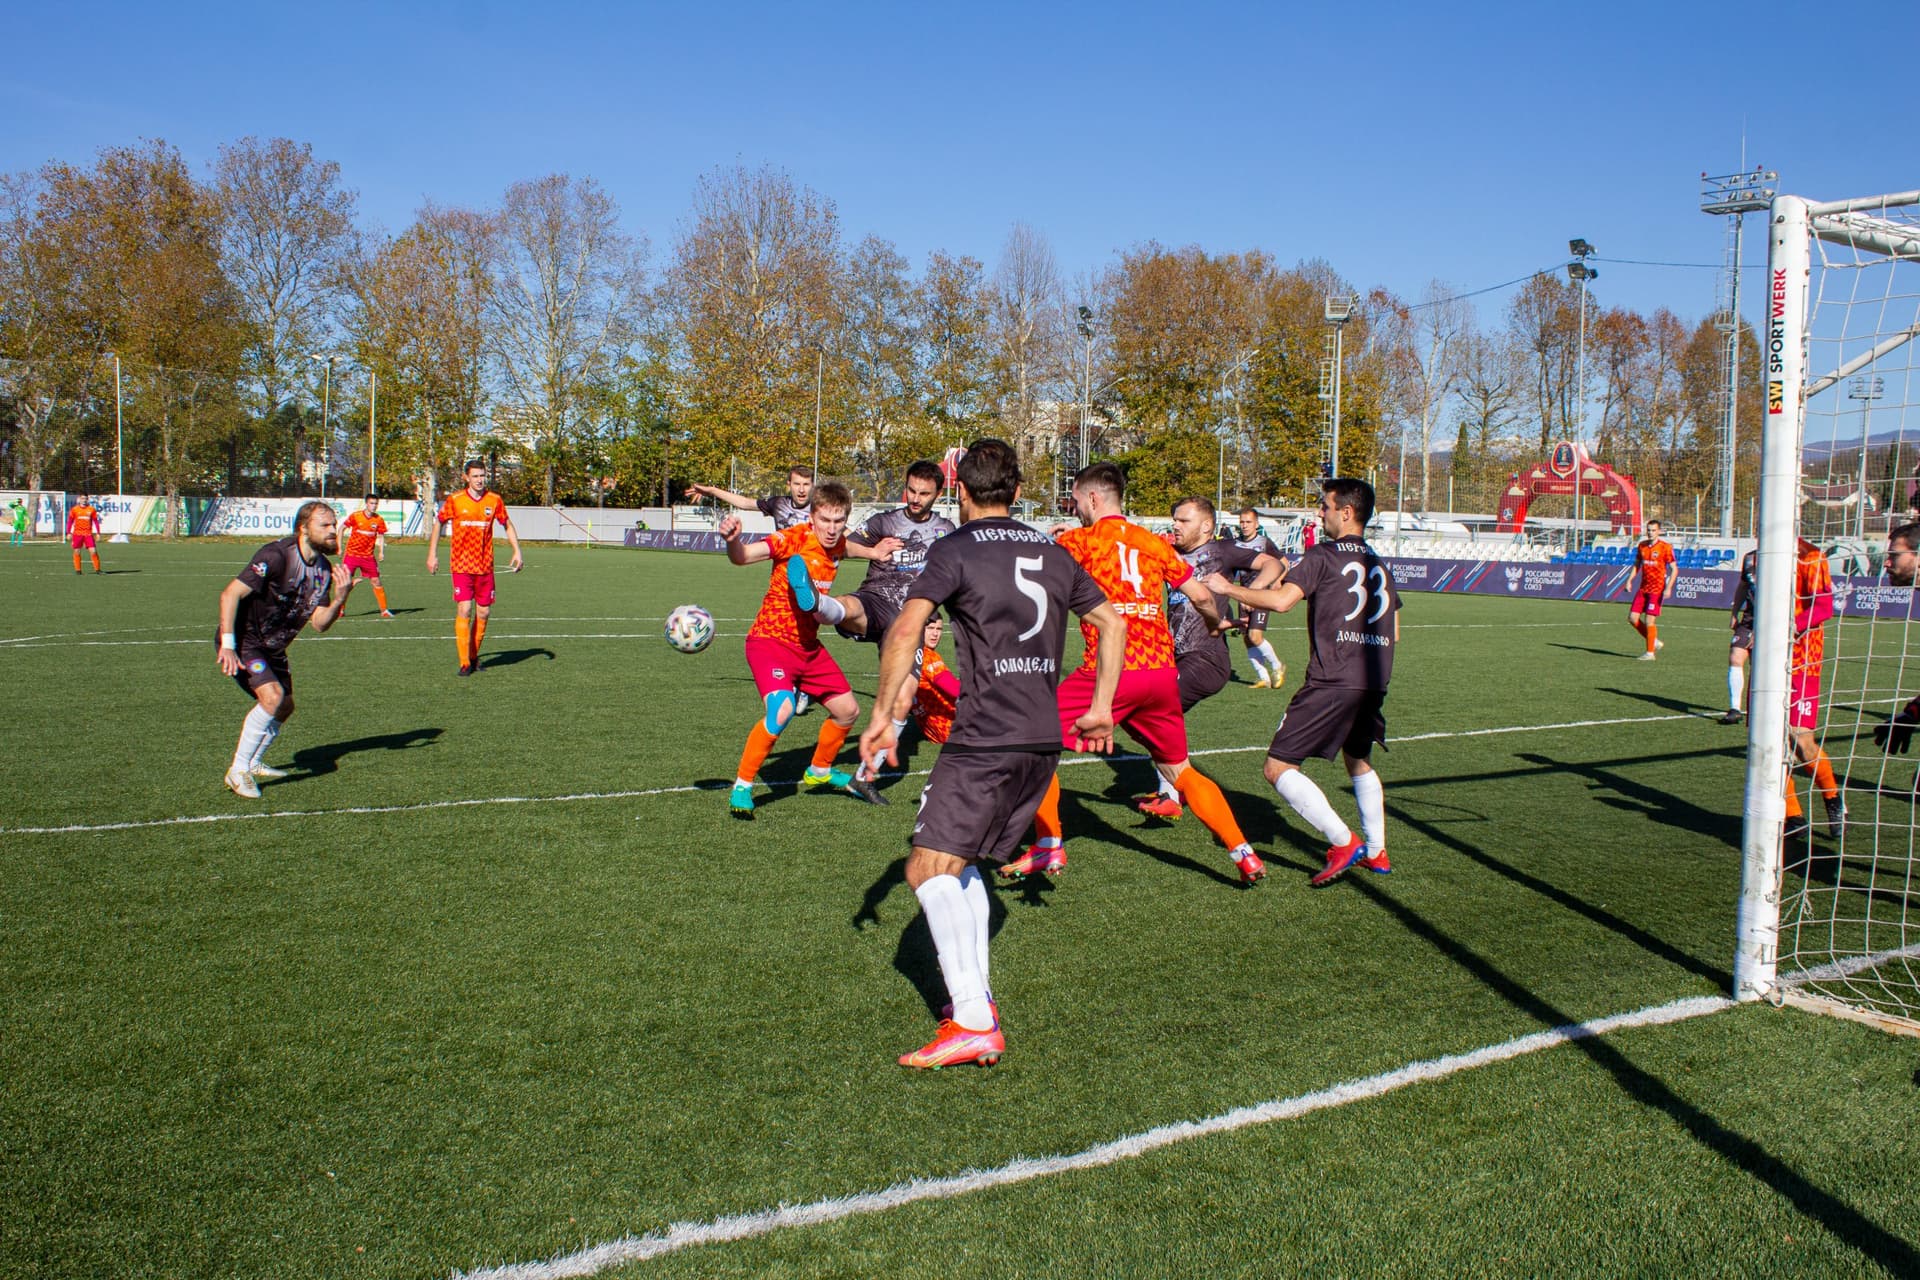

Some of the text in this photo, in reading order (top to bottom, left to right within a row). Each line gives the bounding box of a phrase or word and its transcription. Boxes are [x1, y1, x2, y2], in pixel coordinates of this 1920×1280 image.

[1769, 268, 1787, 412] SW SPORTWERK
[225, 514, 260, 529] 2020
[1116, 541, 1145, 598] 4
[1525, 570, 1565, 578] РОССИЙСКИЙ
[1525, 577, 1565, 585] ФУТБОЛЬНЫЙ
[1677, 576, 1723, 587] РОССИЙСКИЙ
[1524, 583, 1542, 591] СОЮЗ
[1676, 584, 1723, 593] ФУТБОЛЬНЫЙ
[1341, 561, 1390, 624] 33
[1676, 591, 1697, 599] СОЮЗ
[1014, 554, 1049, 643] 5
[1856, 602, 1880, 610] СОЮЗ
[1257, 612, 1266, 622] 17
